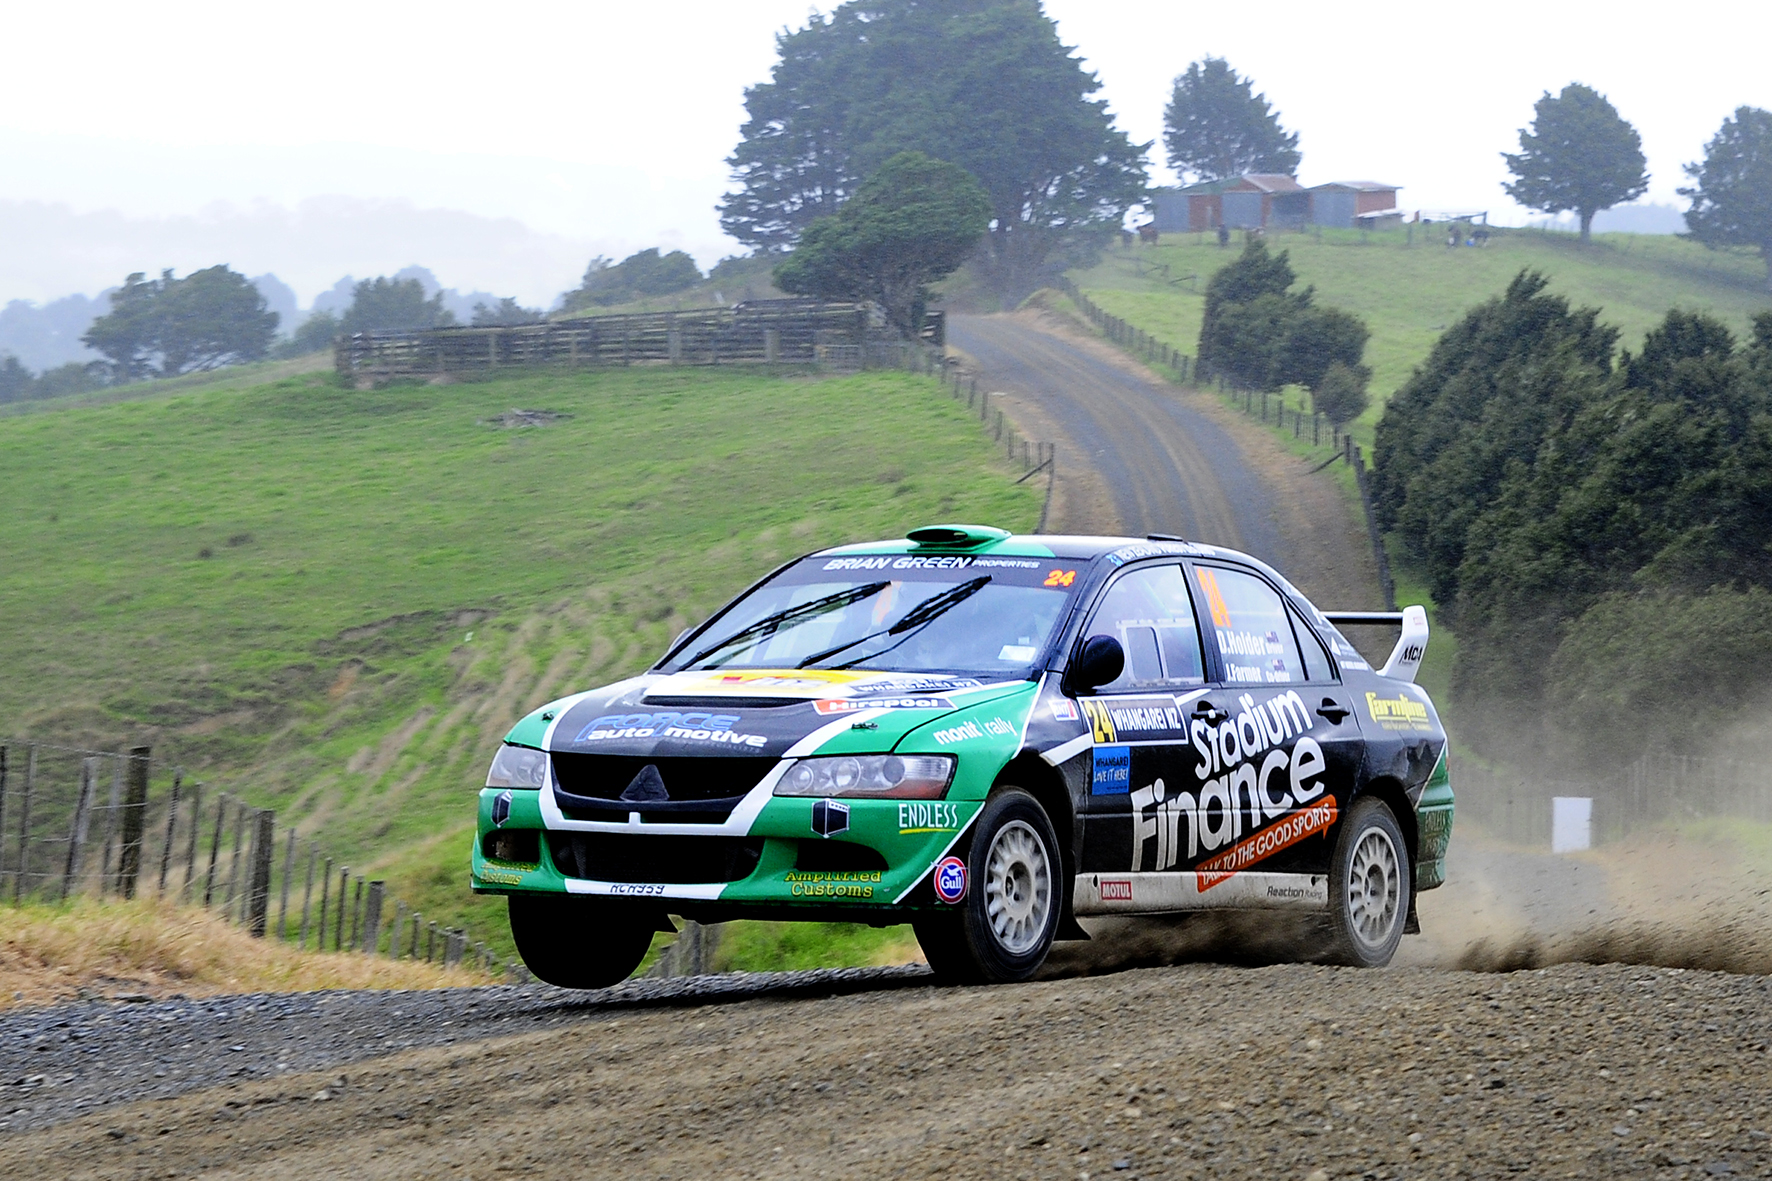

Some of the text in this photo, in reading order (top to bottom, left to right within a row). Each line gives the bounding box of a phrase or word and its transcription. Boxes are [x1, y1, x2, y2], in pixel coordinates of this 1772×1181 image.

[822, 557, 1041, 571] BRIAN GREEN PROPERTIES
[1043, 570, 1077, 587] 24
[1197, 567, 1232, 628] 24
[1216, 630, 1267, 655] D.Holder
[574, 712, 741, 742] FORCE
[933, 717, 1018, 745] monit rally
[1084, 700, 1181, 743] 24 WHANGAREI NZ
[1191, 690, 1314, 780] Stadium
[1095, 756, 1129, 767] WHANGAREI
[1094, 770, 1107, 783] LOVE
[1107, 768, 1115, 781] IT
[1130, 737, 1326, 872] Finance
[898, 803, 958, 828] ENDLESS
[1223, 851, 1236, 870] TO
[1237, 840, 1255, 866] THE
[1256, 822, 1292, 855] GOOD
[1292, 803, 1331, 837] SPORTS
[784, 871, 882, 883] Amplified
[940, 876, 962, 890] Gull
[791, 882, 873, 897] Customs
[1102, 883, 1130, 898] MOTUL
[1266, 885, 1304, 898] Reaction
